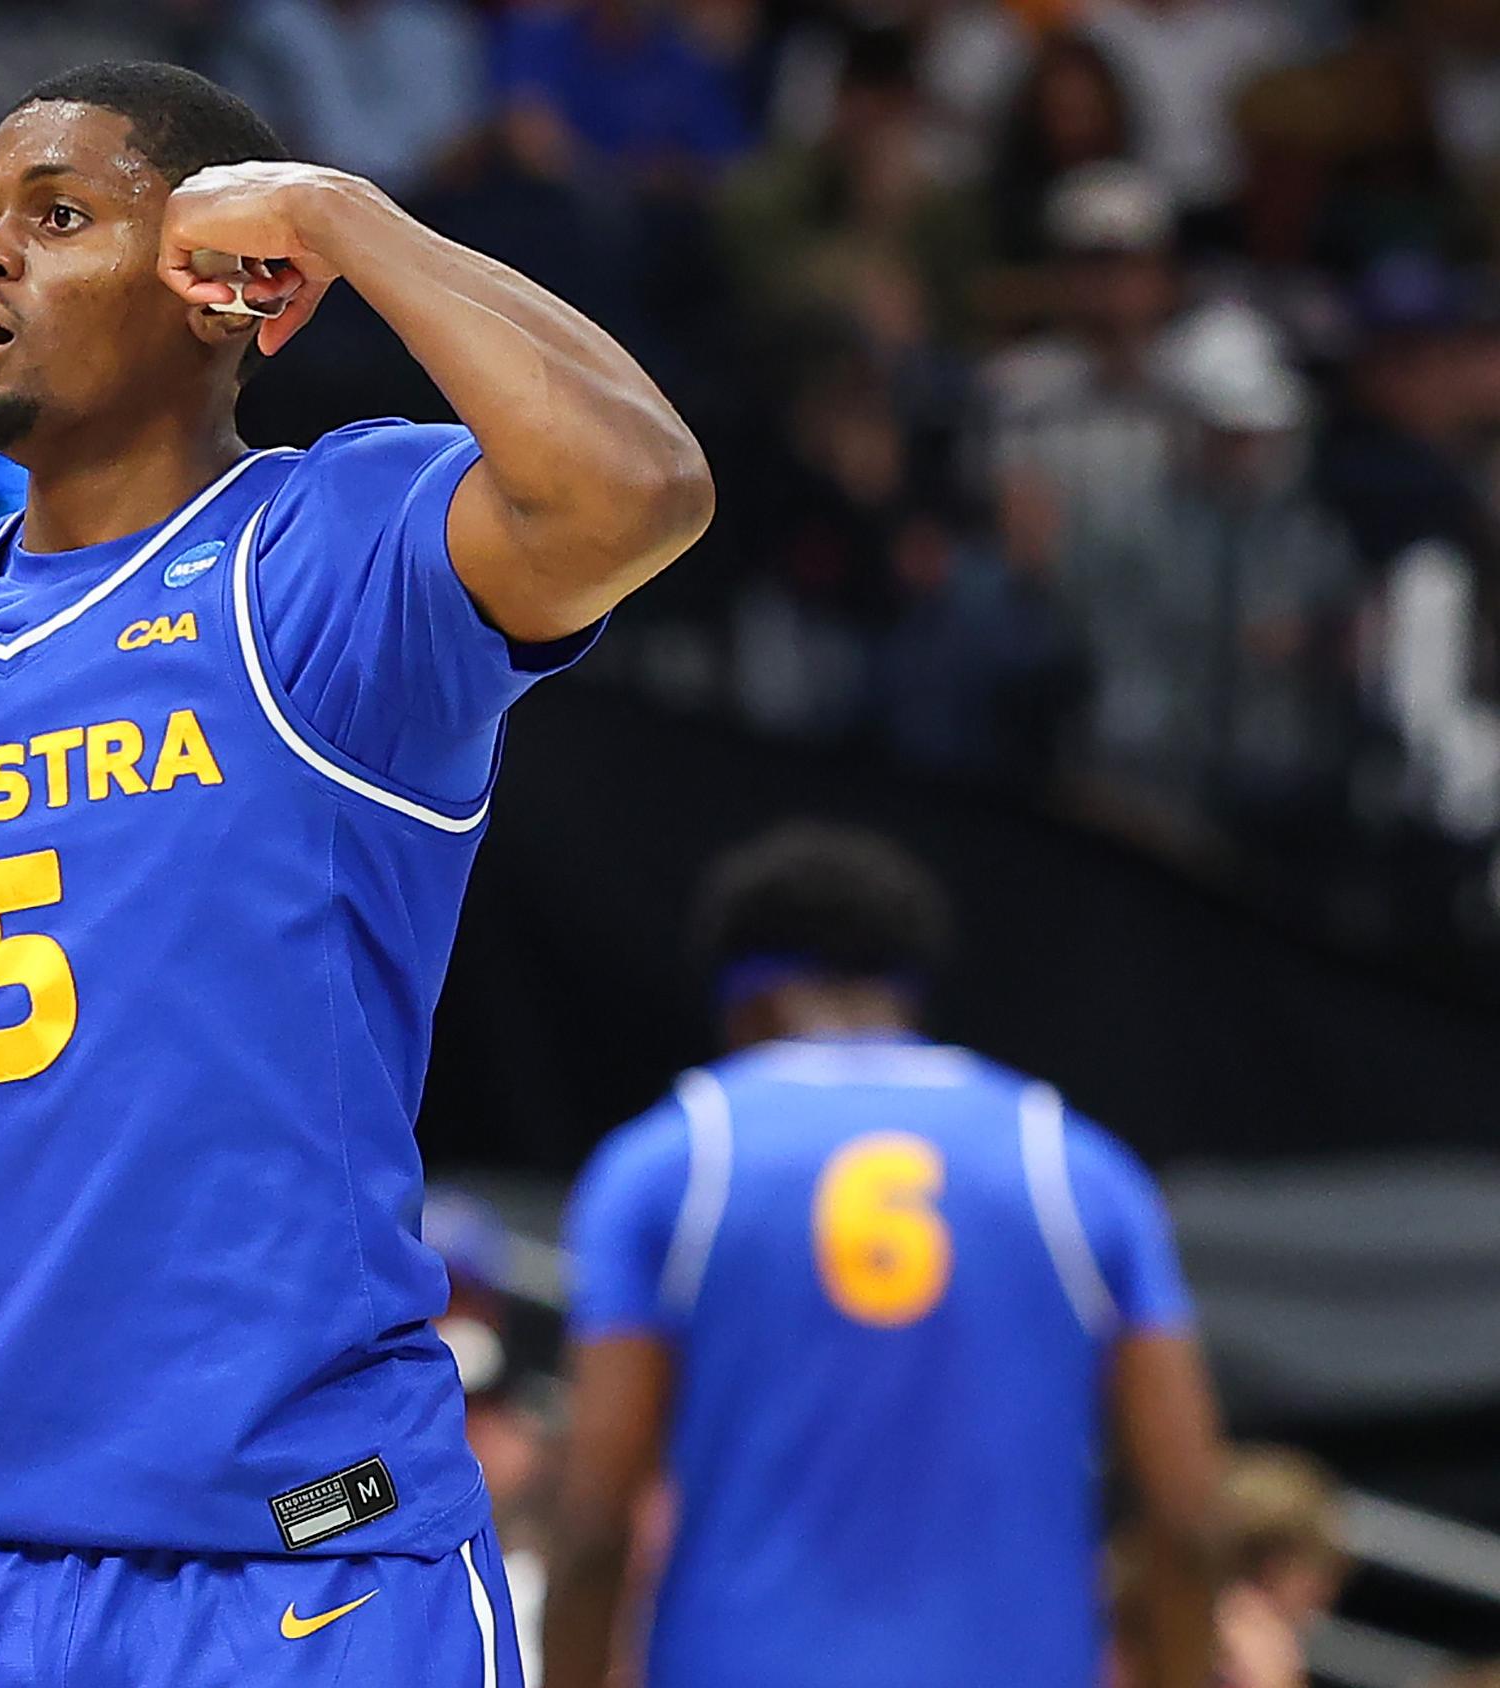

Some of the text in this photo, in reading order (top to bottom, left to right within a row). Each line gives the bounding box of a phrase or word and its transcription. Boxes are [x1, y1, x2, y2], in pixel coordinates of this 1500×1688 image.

[116, 611, 198, 651] CAA
[811, 1130, 956, 1328] 6
[357, 1476, 381, 1504] M
